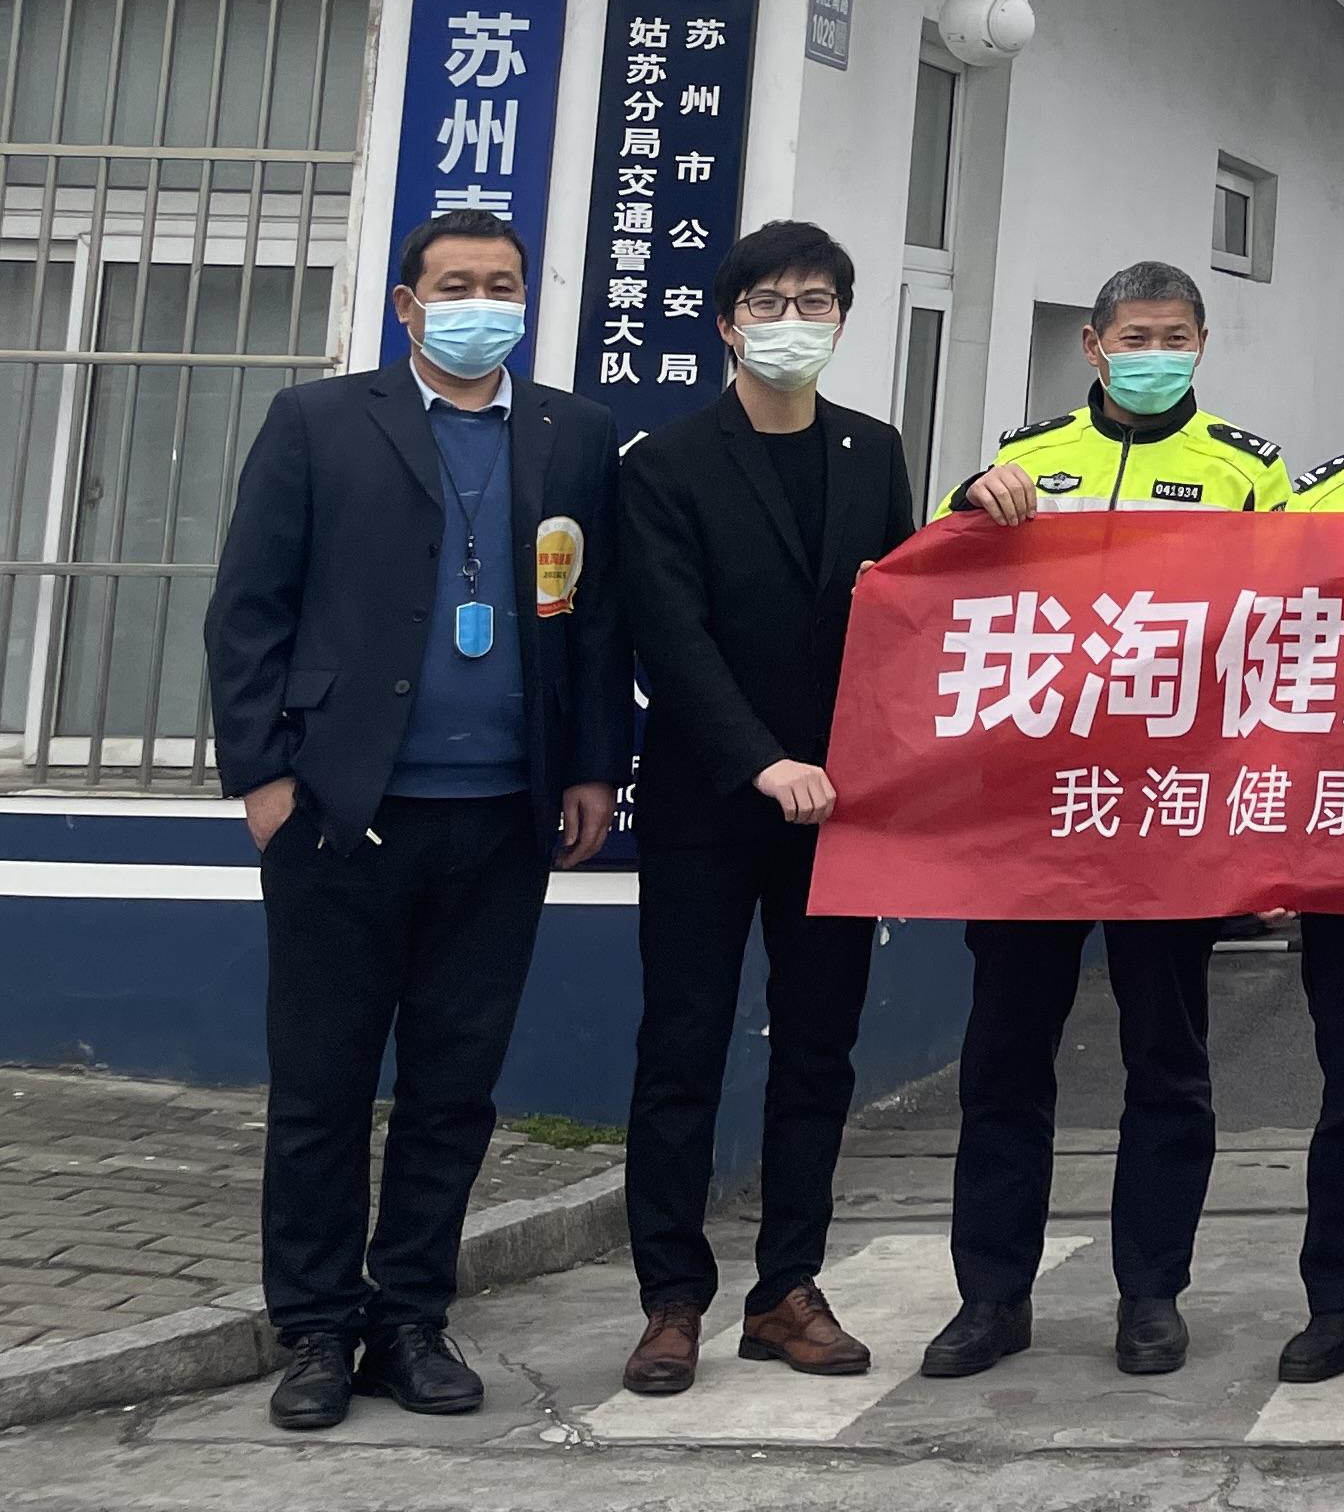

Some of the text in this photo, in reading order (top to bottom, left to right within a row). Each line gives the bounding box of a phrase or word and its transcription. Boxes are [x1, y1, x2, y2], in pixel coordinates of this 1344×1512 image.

[812, 14, 835, 49] 1028
[600, 17, 670, 385] 姑苏分局交通警察大队
[656, 18, 726, 386] 苏州市公安局
[1155, 484, 1199, 499] 041934
